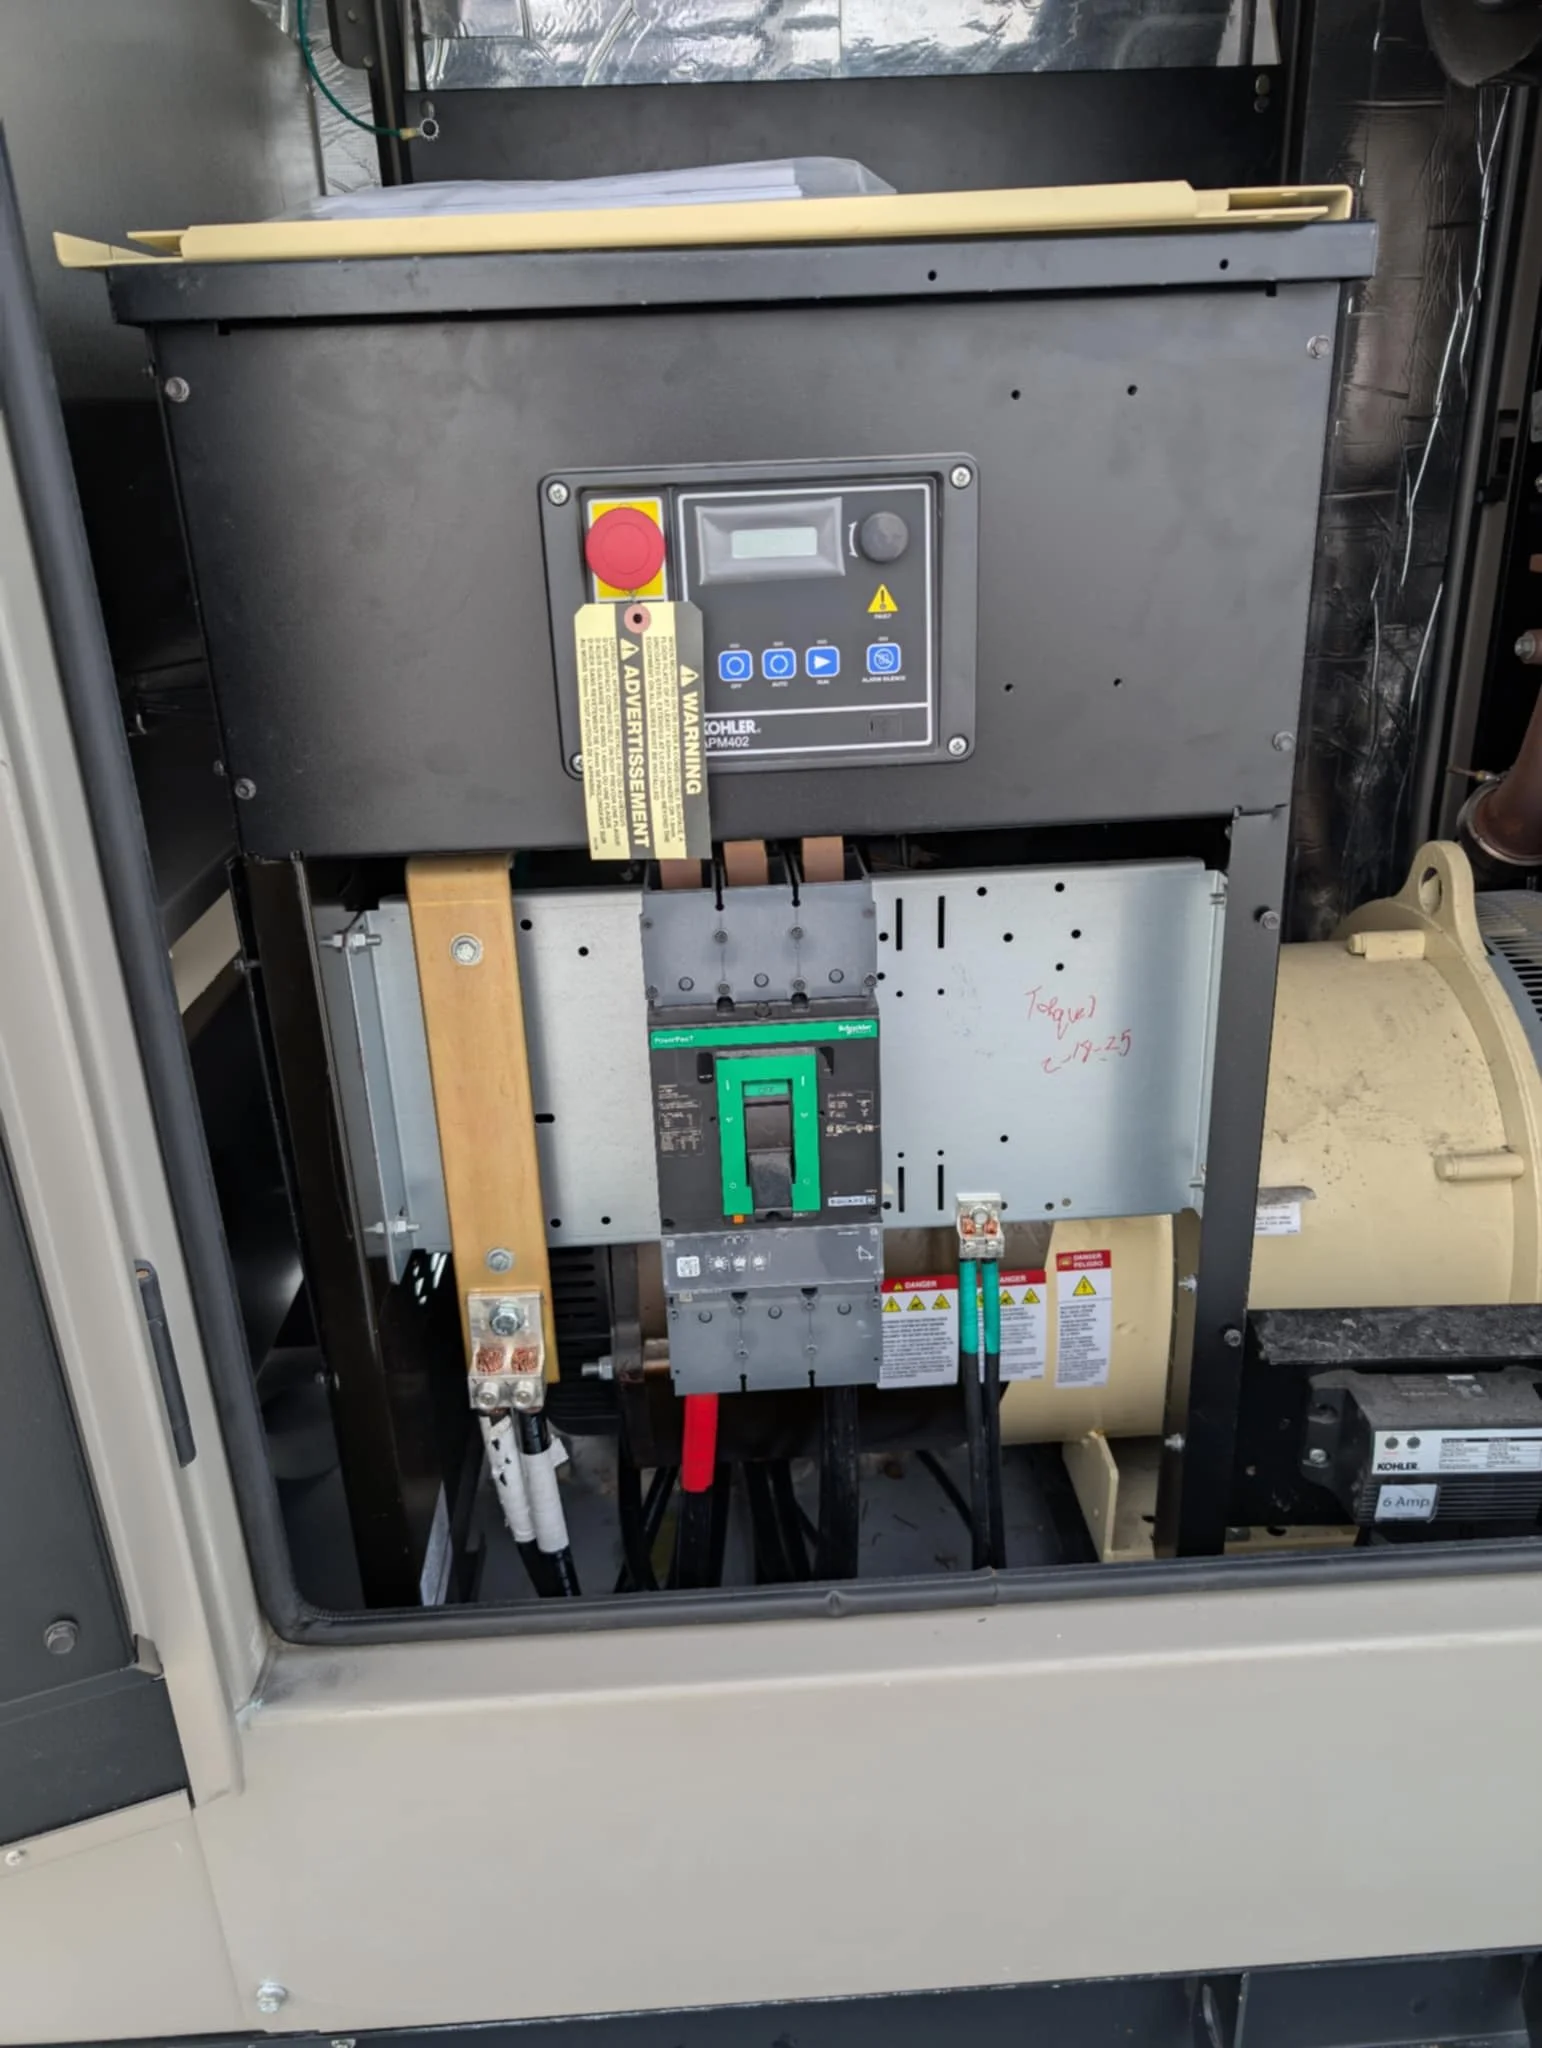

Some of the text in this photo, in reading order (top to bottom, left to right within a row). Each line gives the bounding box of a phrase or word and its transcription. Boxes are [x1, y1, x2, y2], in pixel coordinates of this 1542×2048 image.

[680, 691, 702, 794] WARNING
[622, 664, 649, 848] ADVERTISSEMENT
[1073, 1252, 1102, 1261] DANGER
[999, 1274, 1027, 1283] ANGER
[904, 1280, 938, 1289] DANGER
[1377, 1461, 1419, 1471] KOHLER
[1382, 1496, 1430, 1508] 6 Amp
